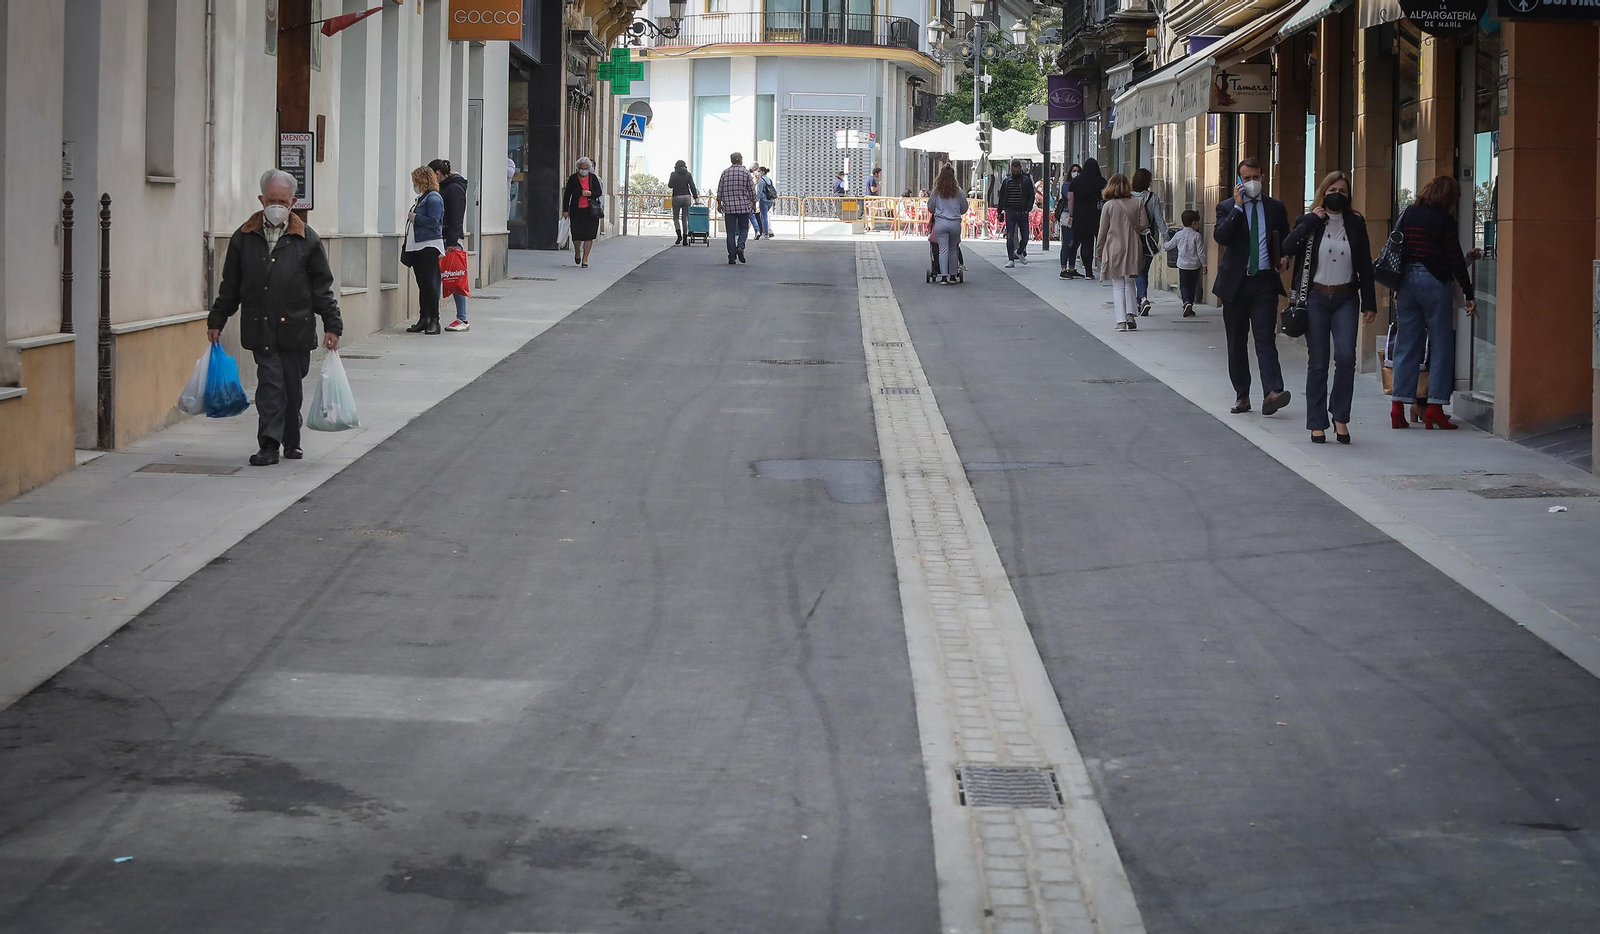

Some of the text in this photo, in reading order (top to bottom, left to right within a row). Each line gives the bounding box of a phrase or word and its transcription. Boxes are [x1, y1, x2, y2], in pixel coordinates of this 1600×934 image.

[454, 9, 520, 24] GOCCO
[1410, 10, 1477, 20] ALPARGATERÍA
[1229, 78, 1269, 90] Tamara
